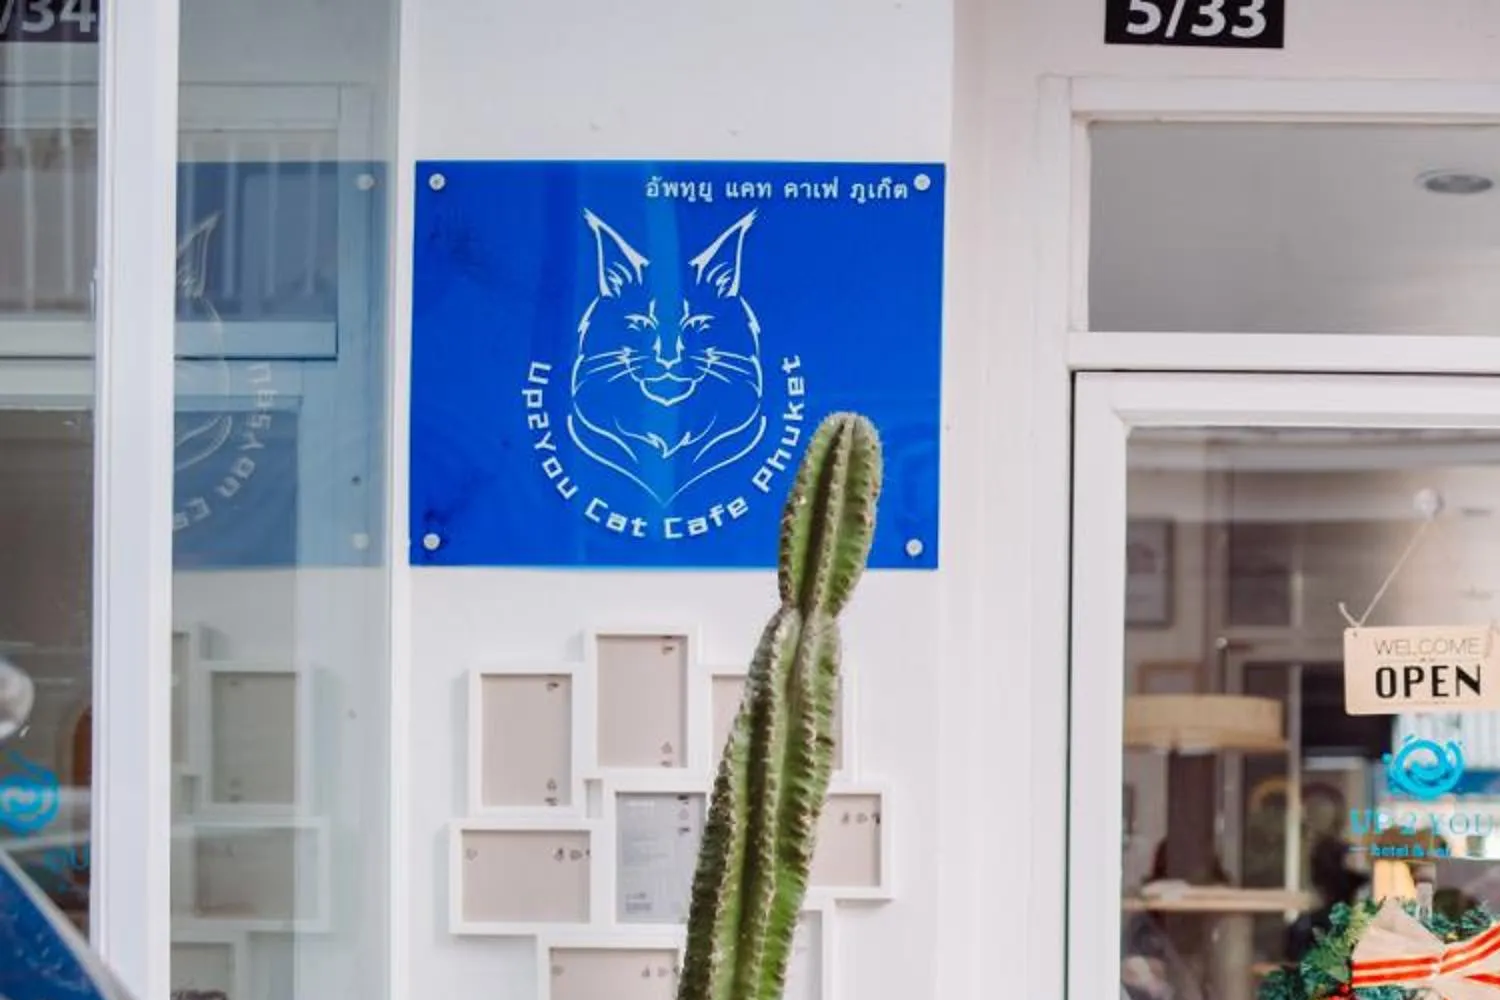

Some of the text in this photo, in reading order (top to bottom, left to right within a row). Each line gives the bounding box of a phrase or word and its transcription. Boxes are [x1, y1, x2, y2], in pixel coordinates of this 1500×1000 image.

[1126, 0, 1267, 38] 5/33
[724, 181, 772, 199] แคท
[584, 497, 648, 538] Cat
[663, 496, 749, 540] Cafe
[751, 354, 806, 494] Phuket
[1373, 637, 1481, 656] WELCOME
[1374, 664, 1483, 699] OPEN
